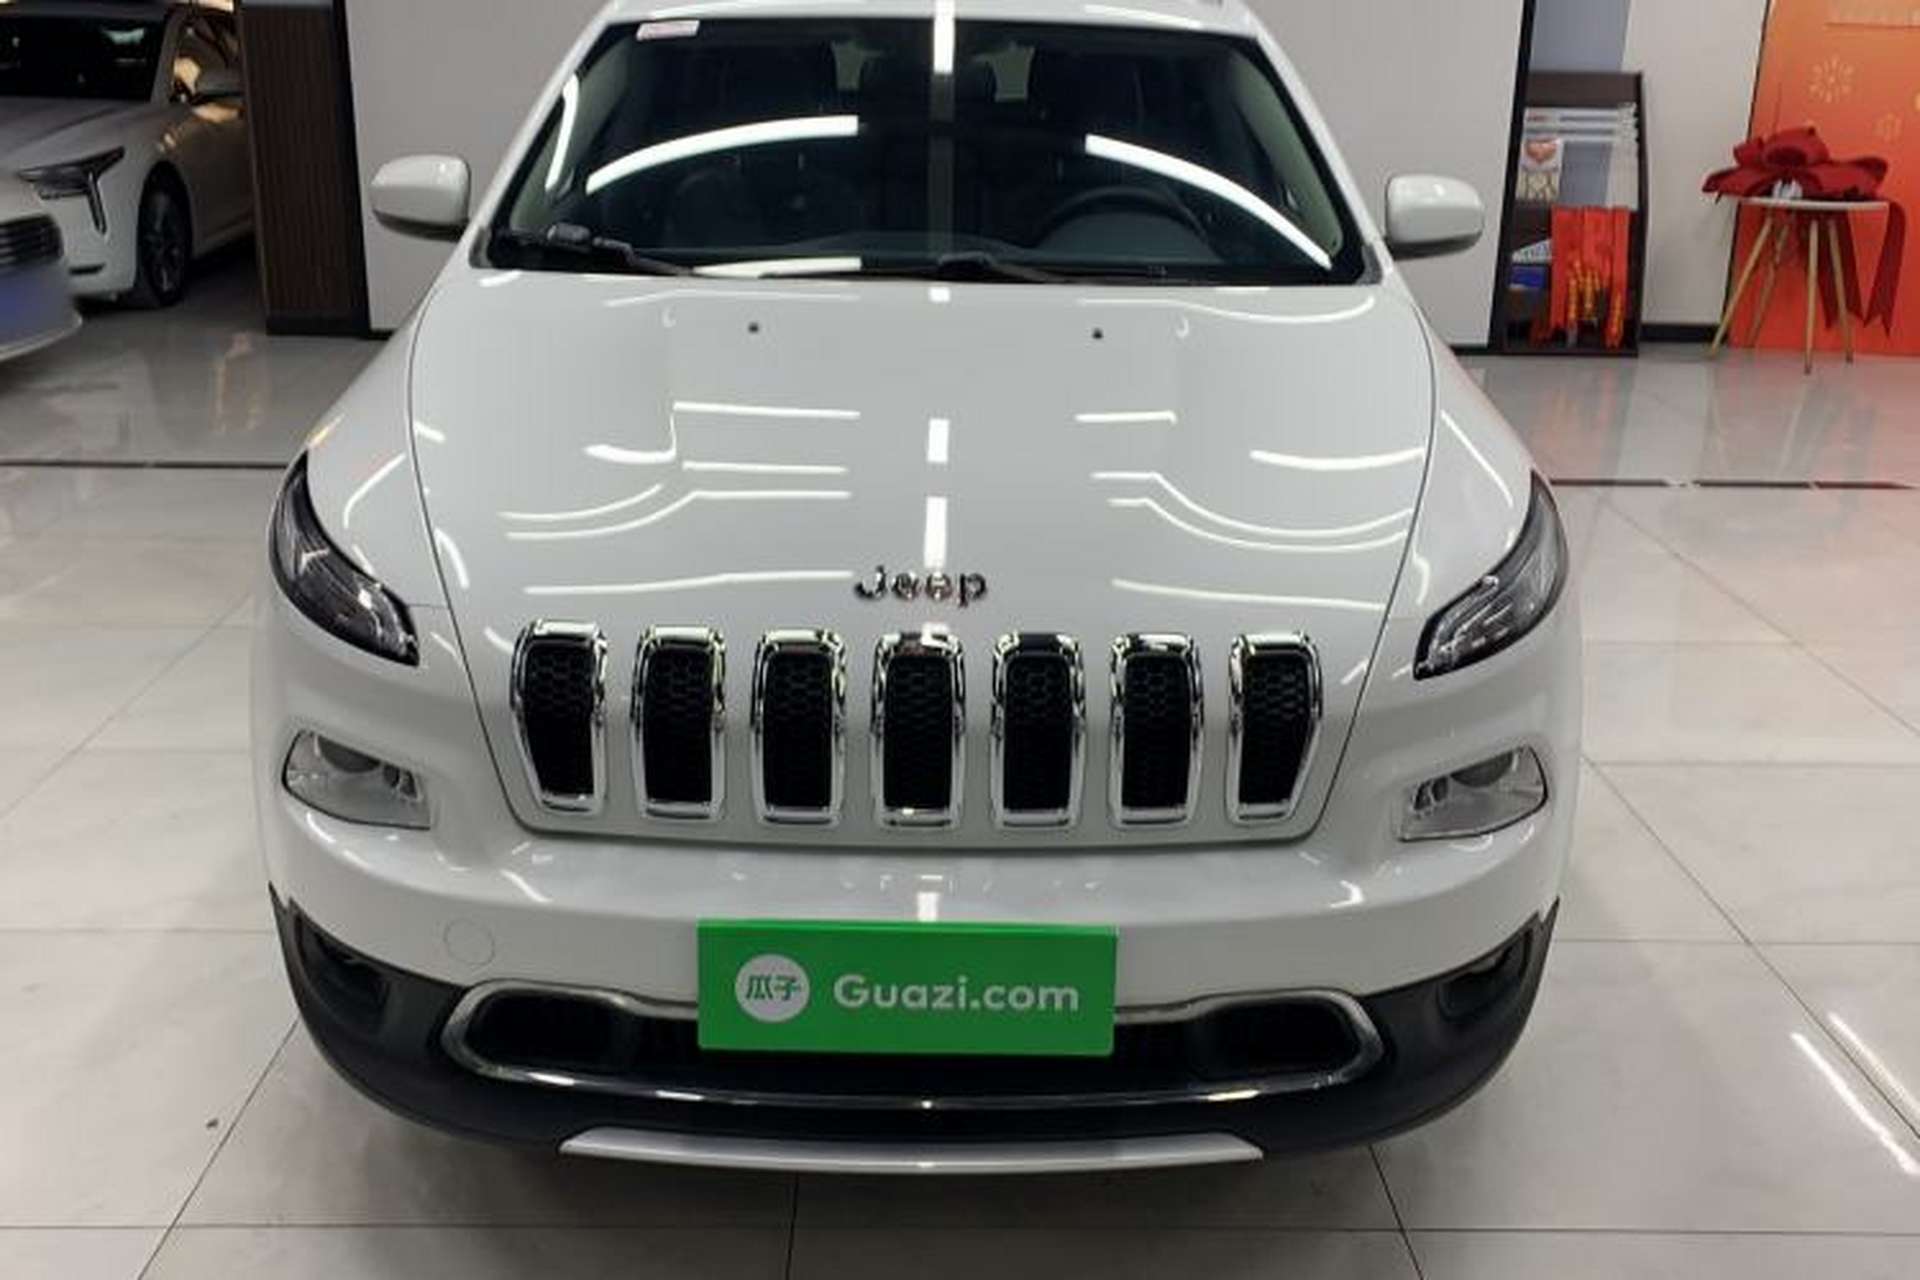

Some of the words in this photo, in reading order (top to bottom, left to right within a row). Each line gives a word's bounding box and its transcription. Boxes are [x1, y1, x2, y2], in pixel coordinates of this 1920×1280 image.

[854, 565, 987, 608] Jeep
[745, 974, 800, 1001] 瓜子
[832, 973, 1080, 1012] Guazi.com
